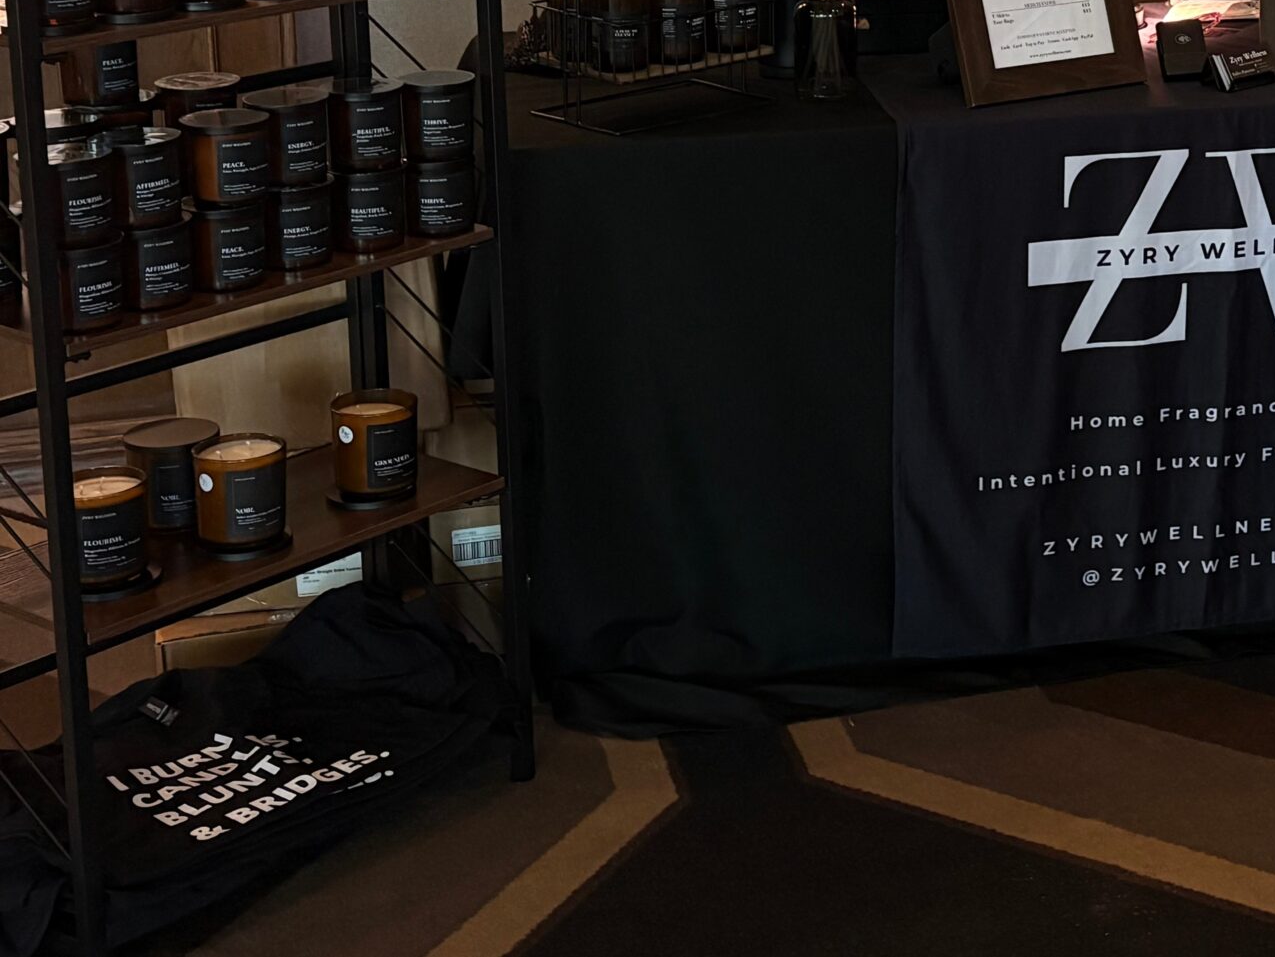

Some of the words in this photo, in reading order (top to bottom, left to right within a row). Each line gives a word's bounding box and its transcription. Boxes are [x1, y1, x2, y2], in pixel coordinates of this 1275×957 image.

[1096, 244, 1181, 267] ZYRY
[1070, 412, 1145, 431] Home
[978, 460, 1142, 491] Intentional
[1157, 450, 1247, 472] Luxury
[107, 775, 129, 791] I
[128, 733, 233, 785] BURN
[189, 825, 231, 841] &
[225, 749, 390, 825] BRIDGES.
